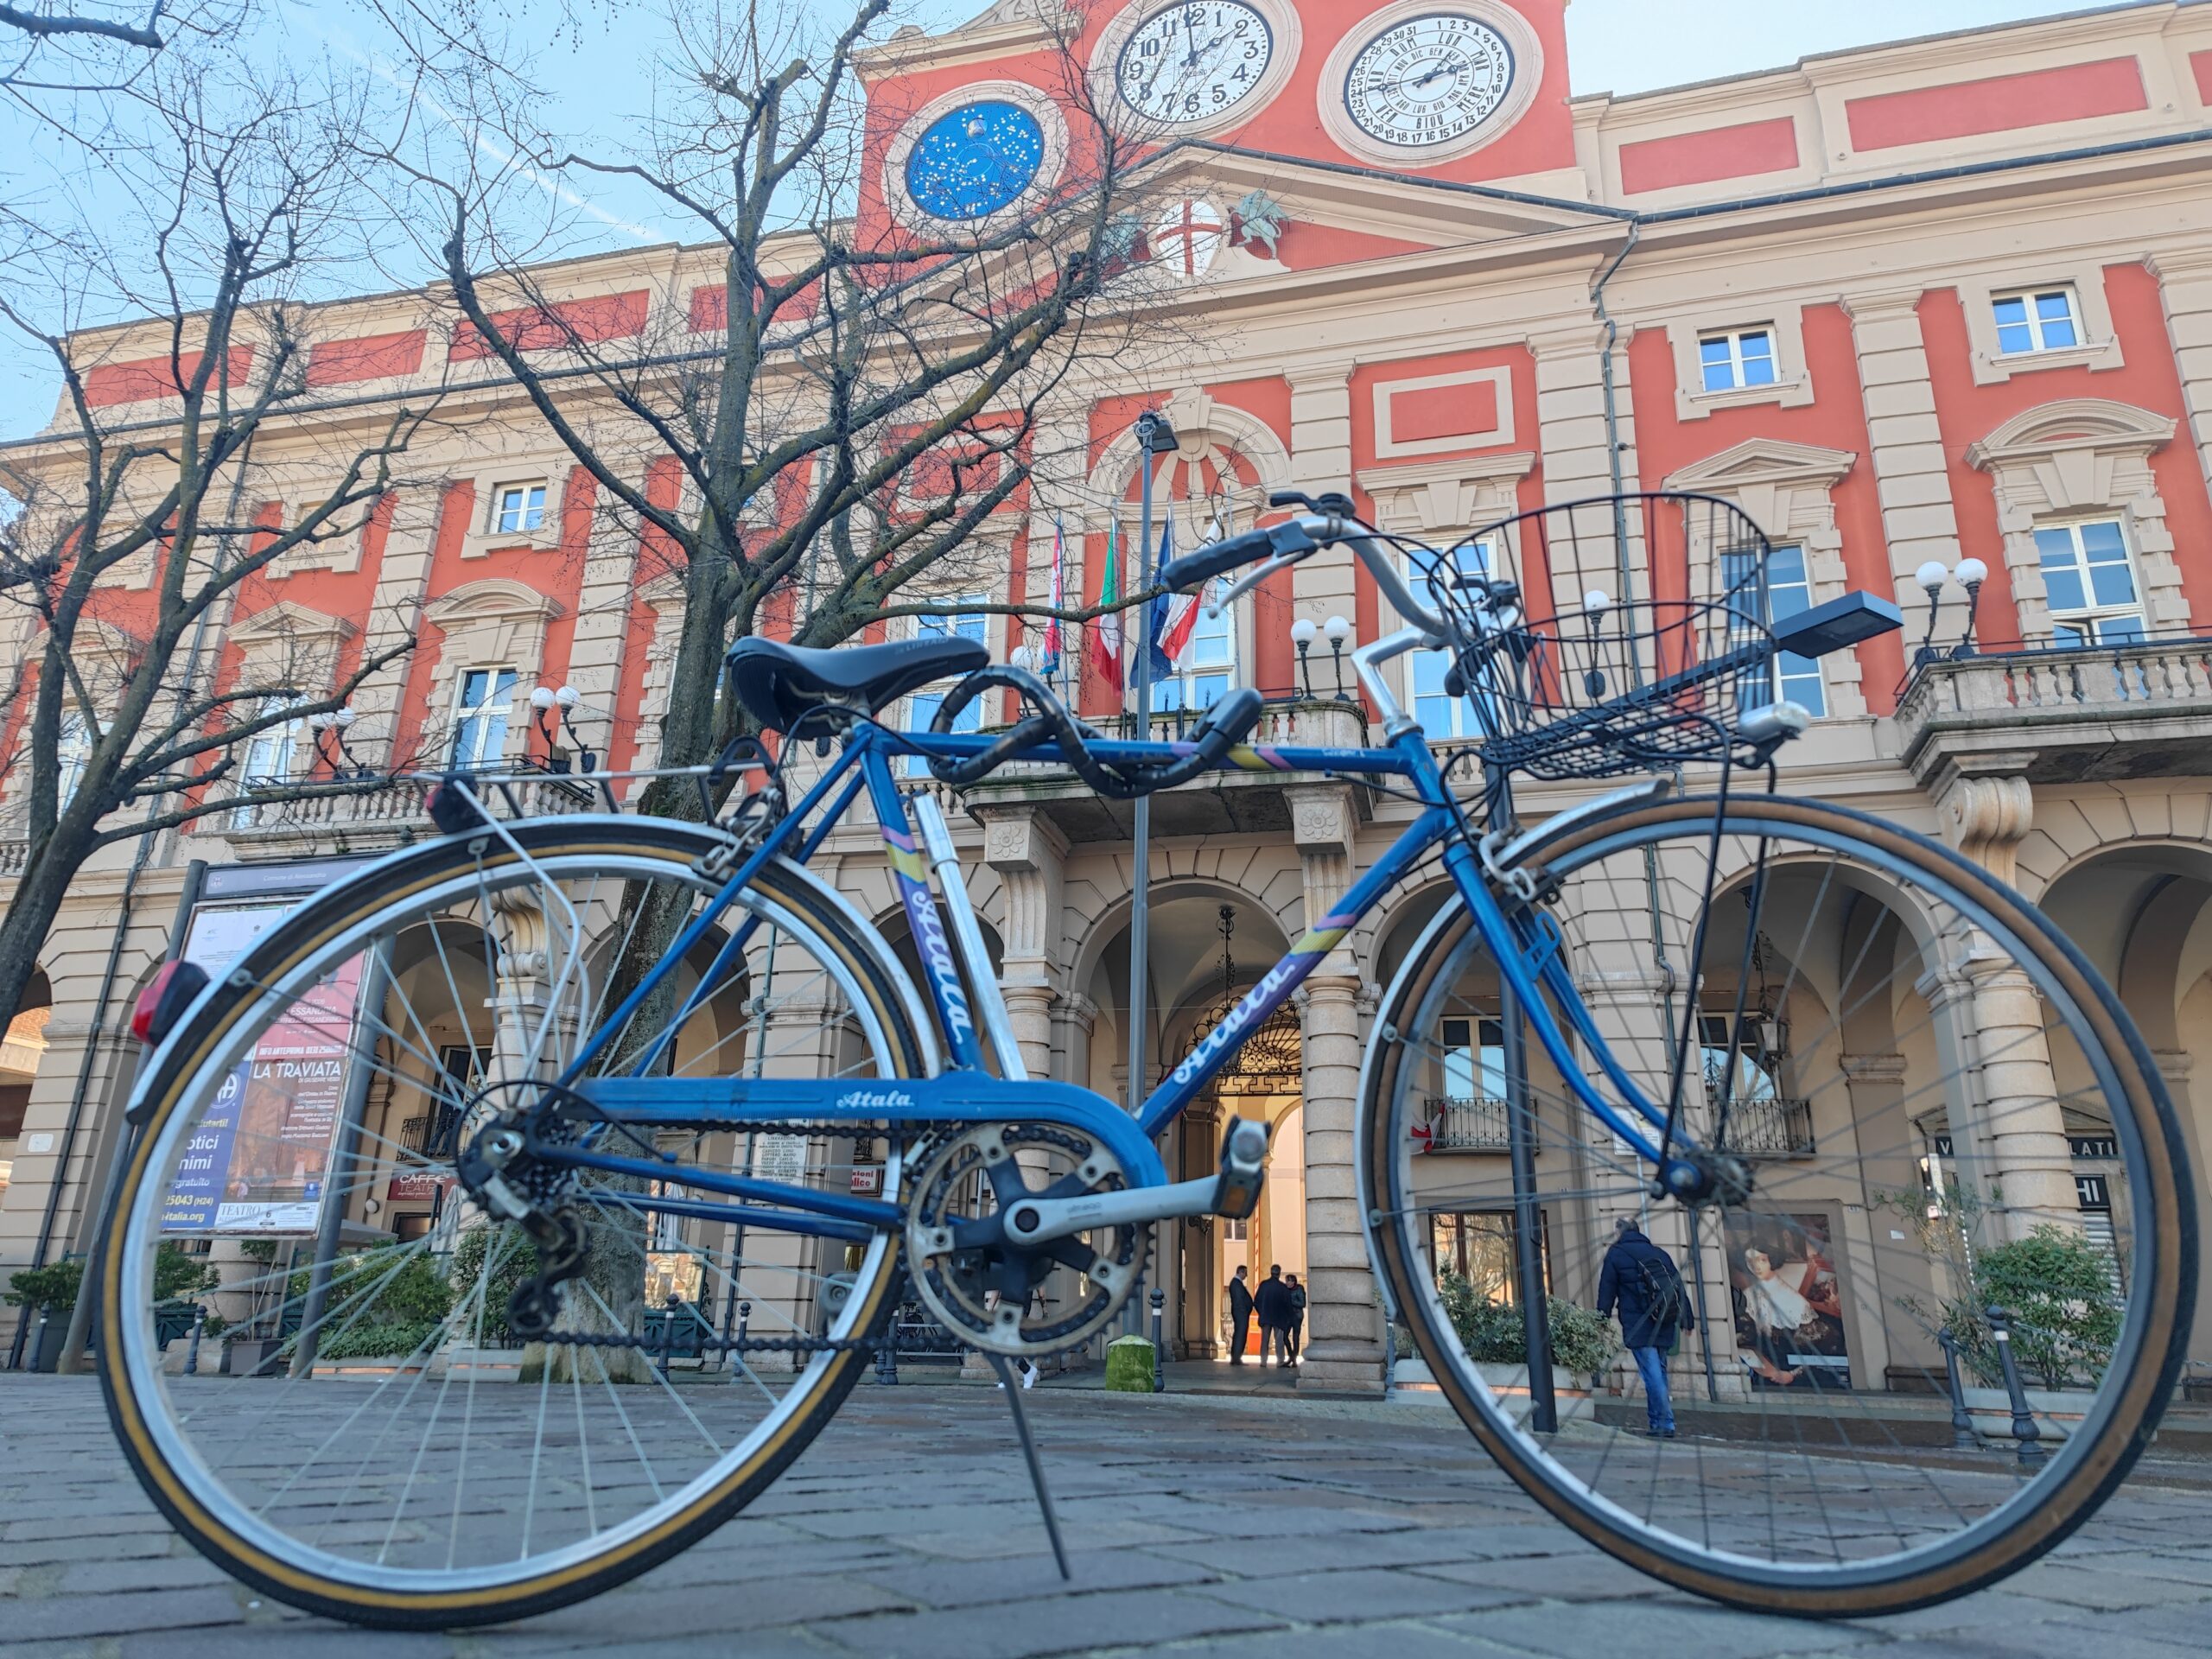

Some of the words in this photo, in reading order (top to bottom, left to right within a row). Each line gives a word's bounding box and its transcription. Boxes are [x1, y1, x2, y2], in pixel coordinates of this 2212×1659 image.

[1215, 9, 1224, 27] 1
[1162, 18, 1178, 38] 11
[1234, 19, 1249, 39] 2
[1437, 20, 1441, 29] 1
[1450, 20, 1457, 29] 2
[1462, 21, 1469, 30] 3
[1393, 30, 1404, 40] 30
[1407, 26, 1416, 35] 31
[1473, 27, 1479, 36] 4
[1381, 36, 1392, 46] 29
[1439, 32, 1462, 46] LUN
[1484, 34, 1491, 43] 5
[1140, 38, 1160, 58] 10
[1243, 40, 1259, 60] 3
[1370, 46, 1382, 55] 28
[1389, 37, 1417, 57] DOM
[1491, 41, 1497, 51] 6
[1362, 56, 1372, 65] 27
[1470, 49, 1490, 71] MAR
[1496, 52, 1503, 61] 7
[1129, 60, 1145, 80] 9
[1230, 63, 1249, 82] 4
[1355, 66, 1365, 76] 26
[1497, 62, 1504, 72] 8
[1351, 77, 1363, 87] 25
[1497, 73, 1503, 83] 9
[1139, 82, 1153, 101] 8
[1212, 84, 1227, 104] 5
[1491, 84, 1501, 94] 10
[1162, 92, 1177, 112] 7
[1185, 92, 1200, 113] 6
[1352, 99, 1363, 109] 23
[1456, 86, 1485, 112] MERC
[1485, 95, 1494, 105] 11
[1356, 108, 1367, 118] 22
[1376, 105, 1398, 123] VEN
[1413, 104, 1427, 113] LUG
[1477, 105, 1487, 116] 12
[1363, 117, 1373, 127] 21
[1416, 114, 1444, 129] GIOV
[1465, 114, 1476, 125] 13
[1373, 124, 1383, 134] 20
[1440, 128, 1450, 138] 15
[1452, 122, 1463, 133] 14
[1385, 129, 1395, 139] 19
[1397, 131, 1408, 143] 18
[1412, 132, 1422, 143] 17
[1426, 130, 1435, 141] 16
[912, 891, 972, 1045] Atala
[1173, 964, 1296, 1084] Atala
[252, 1063, 271, 1079] LA
[276, 1060, 341, 1078] TRAVIATA
[836, 1090, 915, 1109] Atala
[2069, 1141, 2113, 1156] LATI
[221, 1205, 260, 1216] TEATRO
